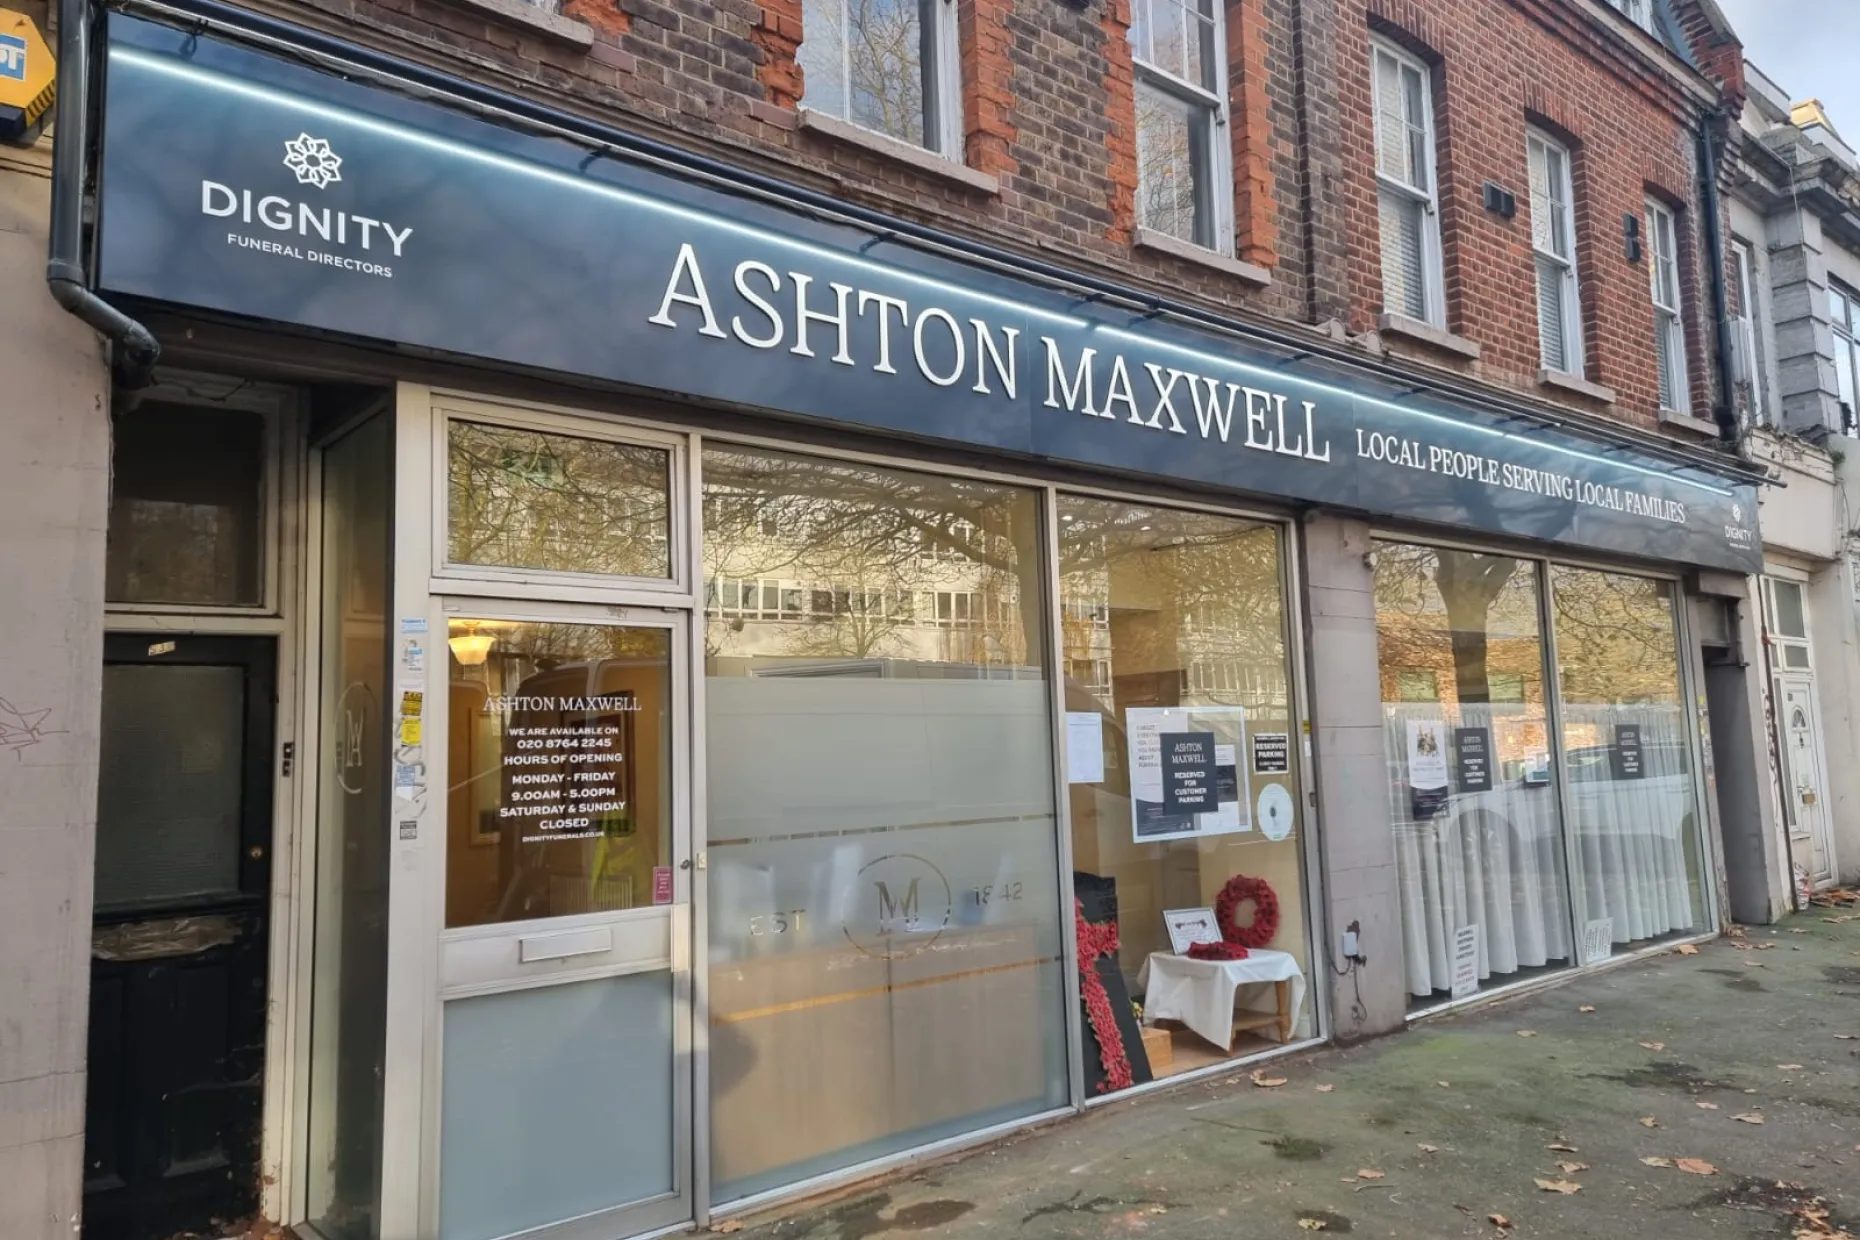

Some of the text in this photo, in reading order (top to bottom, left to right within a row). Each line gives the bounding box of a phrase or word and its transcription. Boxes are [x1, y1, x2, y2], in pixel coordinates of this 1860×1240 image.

[202, 180, 413, 257] DIGNITY
[227, 233, 393, 278] FUNERAL DIRECTORS
[648, 243, 1331, 463] ASHTON MAXWELL
[1356, 428, 1686, 524] LOCAL PEOPLE SERVING LOCAL FAMILIES
[1724, 525, 1752, 541] DIGNITY
[483, 697, 642, 711] ASHTON MAXWELL
[508, 727, 619, 736] WE ARE AVAILABLE ON
[516, 738, 612, 749] 020 8764 2245
[1174, 743, 1203, 753] ASHTON
[504, 753, 623, 765] HOURS OF OPENING
[1172, 754, 1207, 764] MAXWELL
[512, 774, 565, 784] MONDAY
[573, 772, 616, 782] FRIDAY
[1174, 771, 1206, 779] RESERVED
[511, 790, 560, 801] 9.00AM
[569, 787, 616, 798] 5.00PM
[500, 801, 626, 817] SATURDAY & SUNDAY
[539, 818, 589, 829] CLOSED
[750, 908, 806, 936] EST
